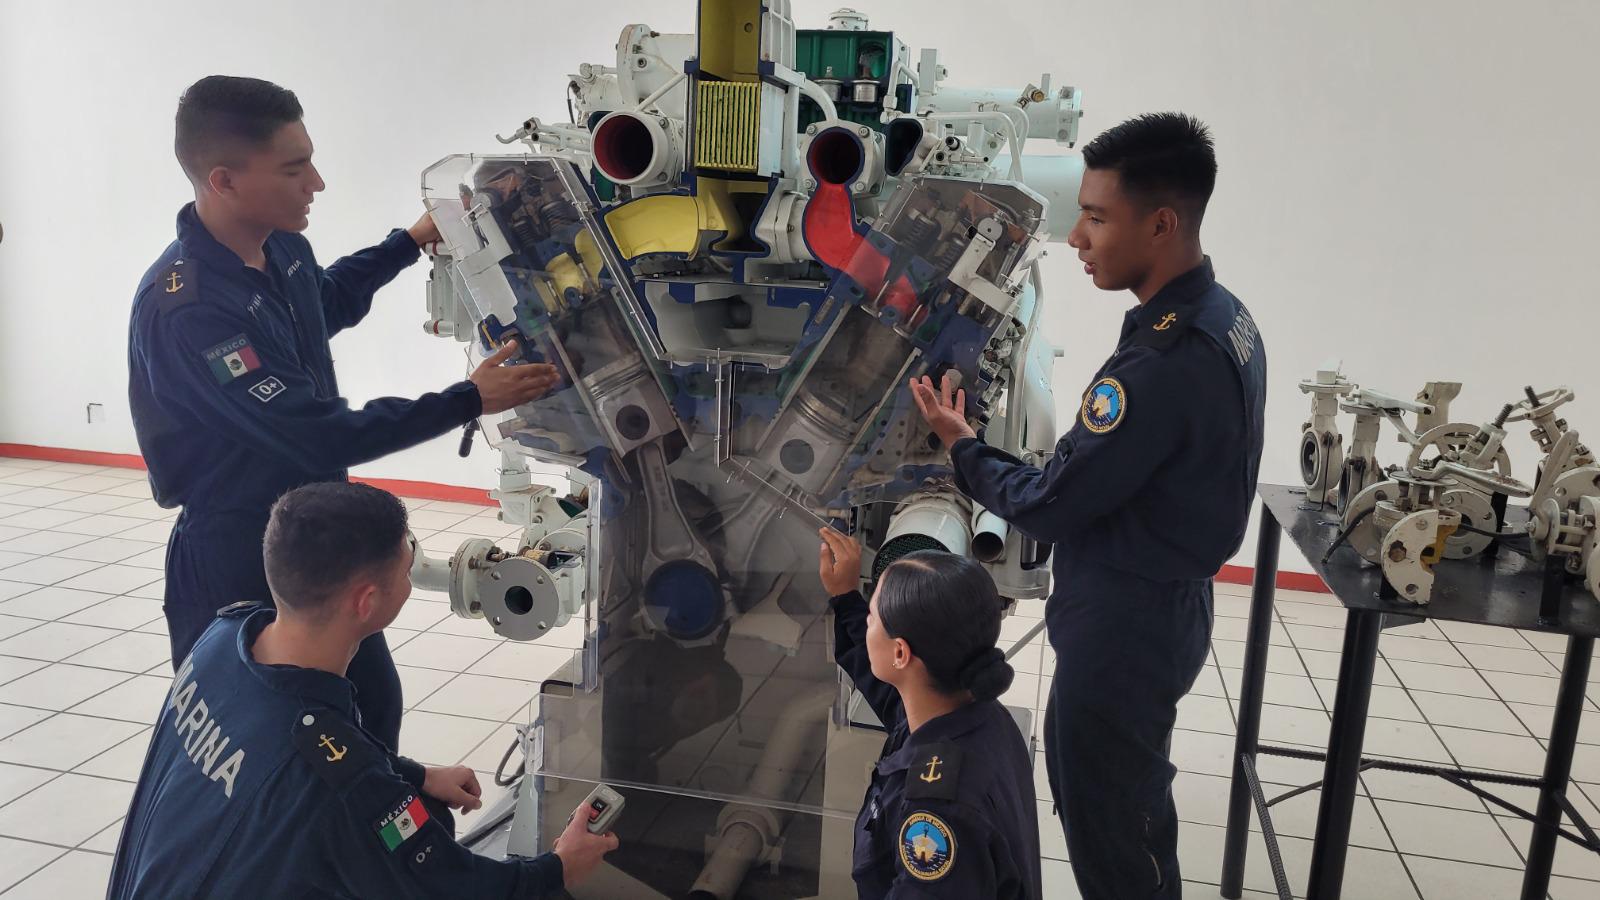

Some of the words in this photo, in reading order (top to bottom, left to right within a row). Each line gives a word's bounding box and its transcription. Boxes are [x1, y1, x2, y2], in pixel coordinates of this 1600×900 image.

[1228, 303, 1258, 367] MARIN
[169, 652, 246, 800] MARINA
[380, 795, 413, 827] MÉXICO
